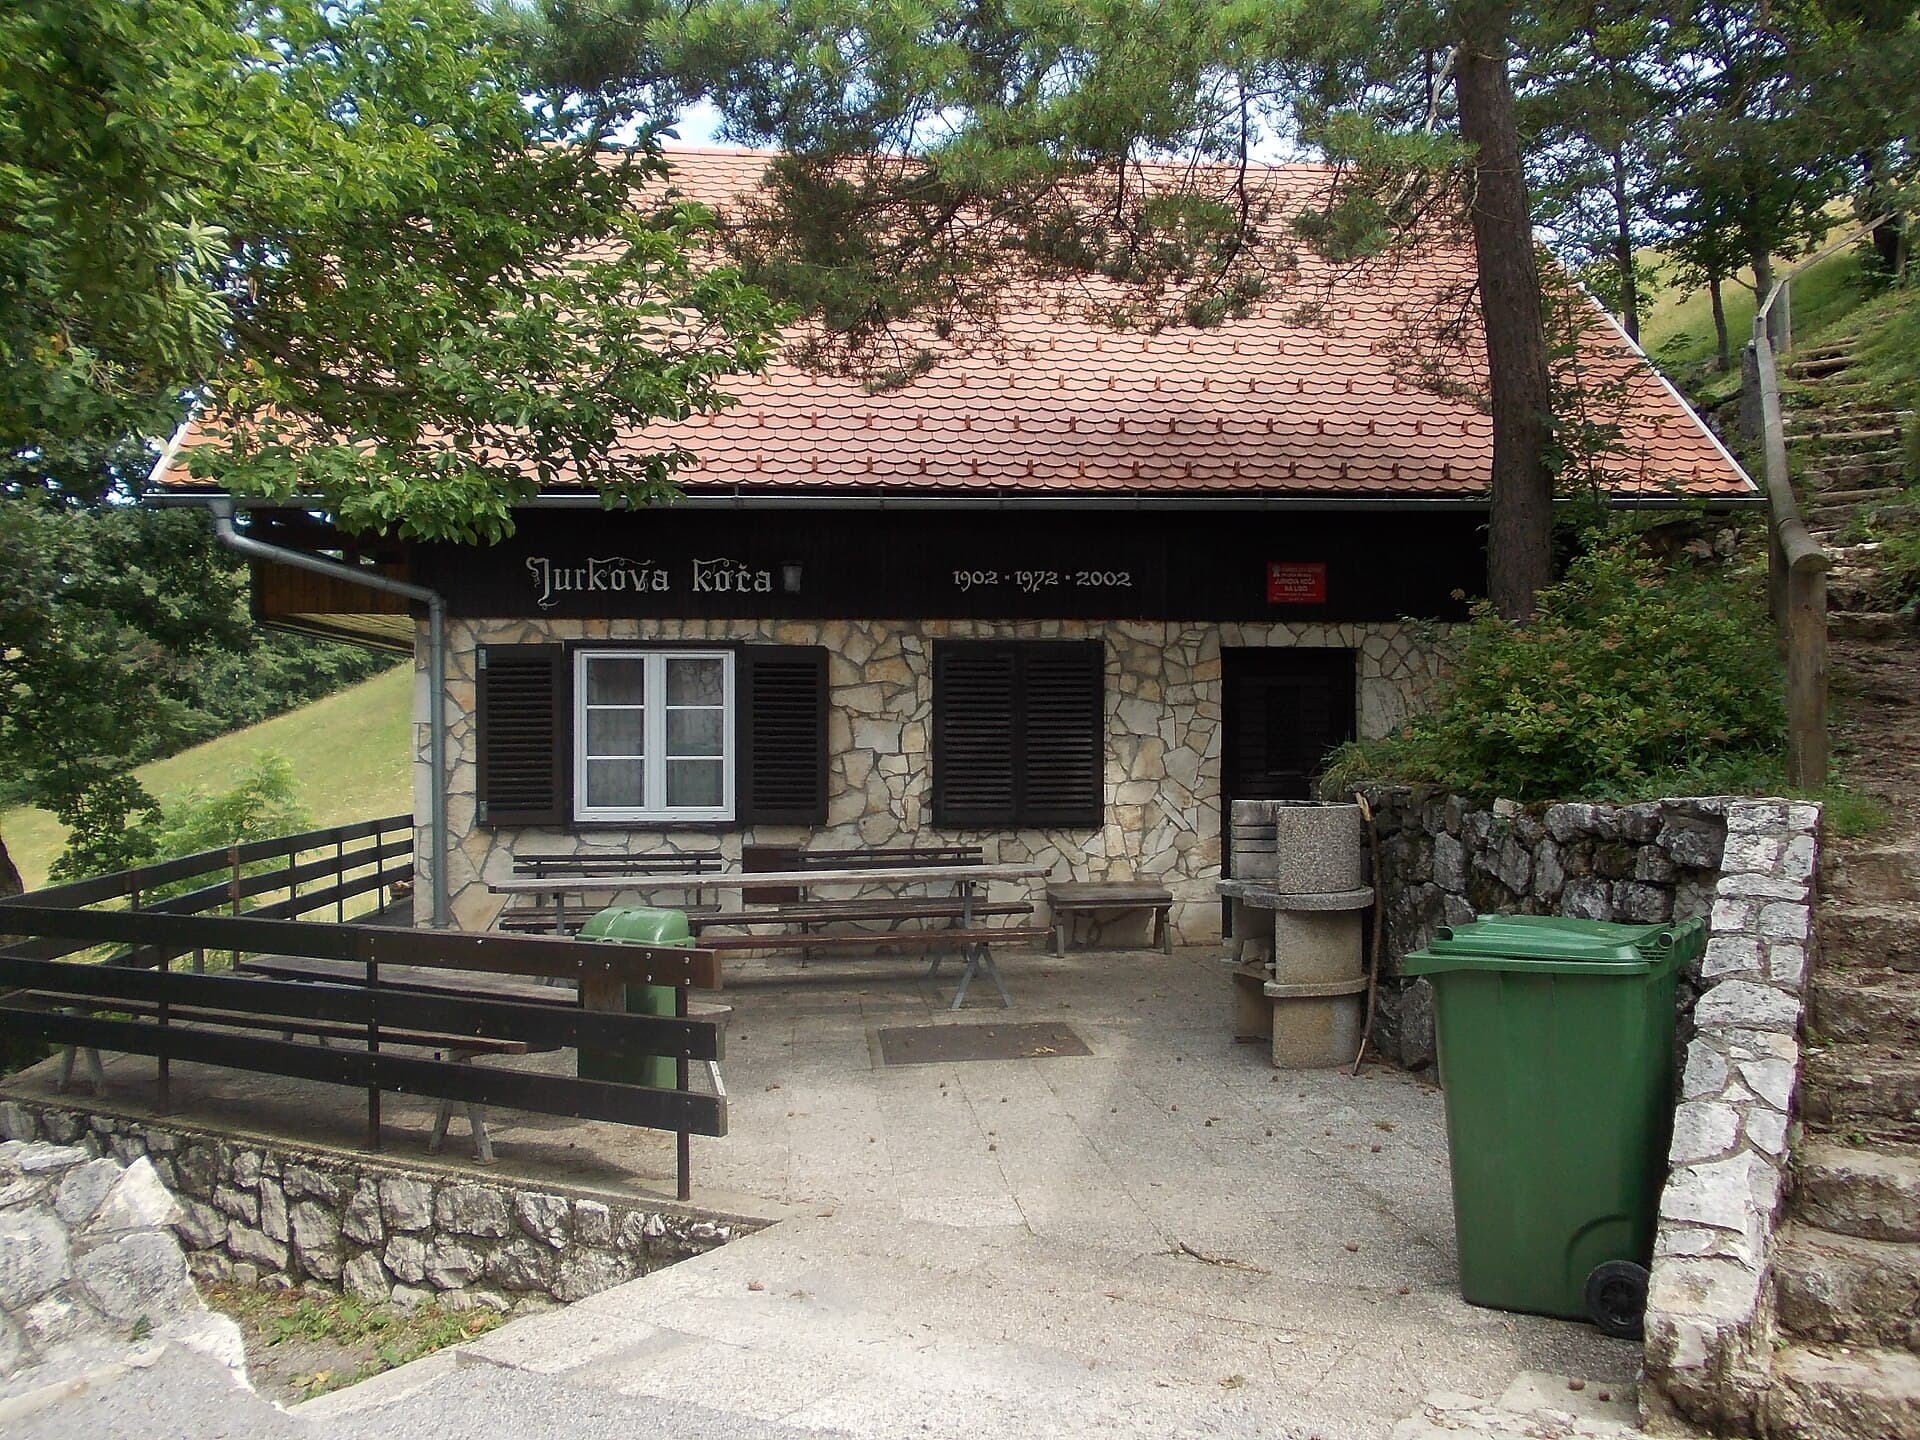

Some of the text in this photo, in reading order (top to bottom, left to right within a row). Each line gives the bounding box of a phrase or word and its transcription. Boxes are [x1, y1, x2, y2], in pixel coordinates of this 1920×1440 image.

[525, 556, 773, 610] Jurkova koča
[952, 570, 1133, 592] 1902 1972 2002
